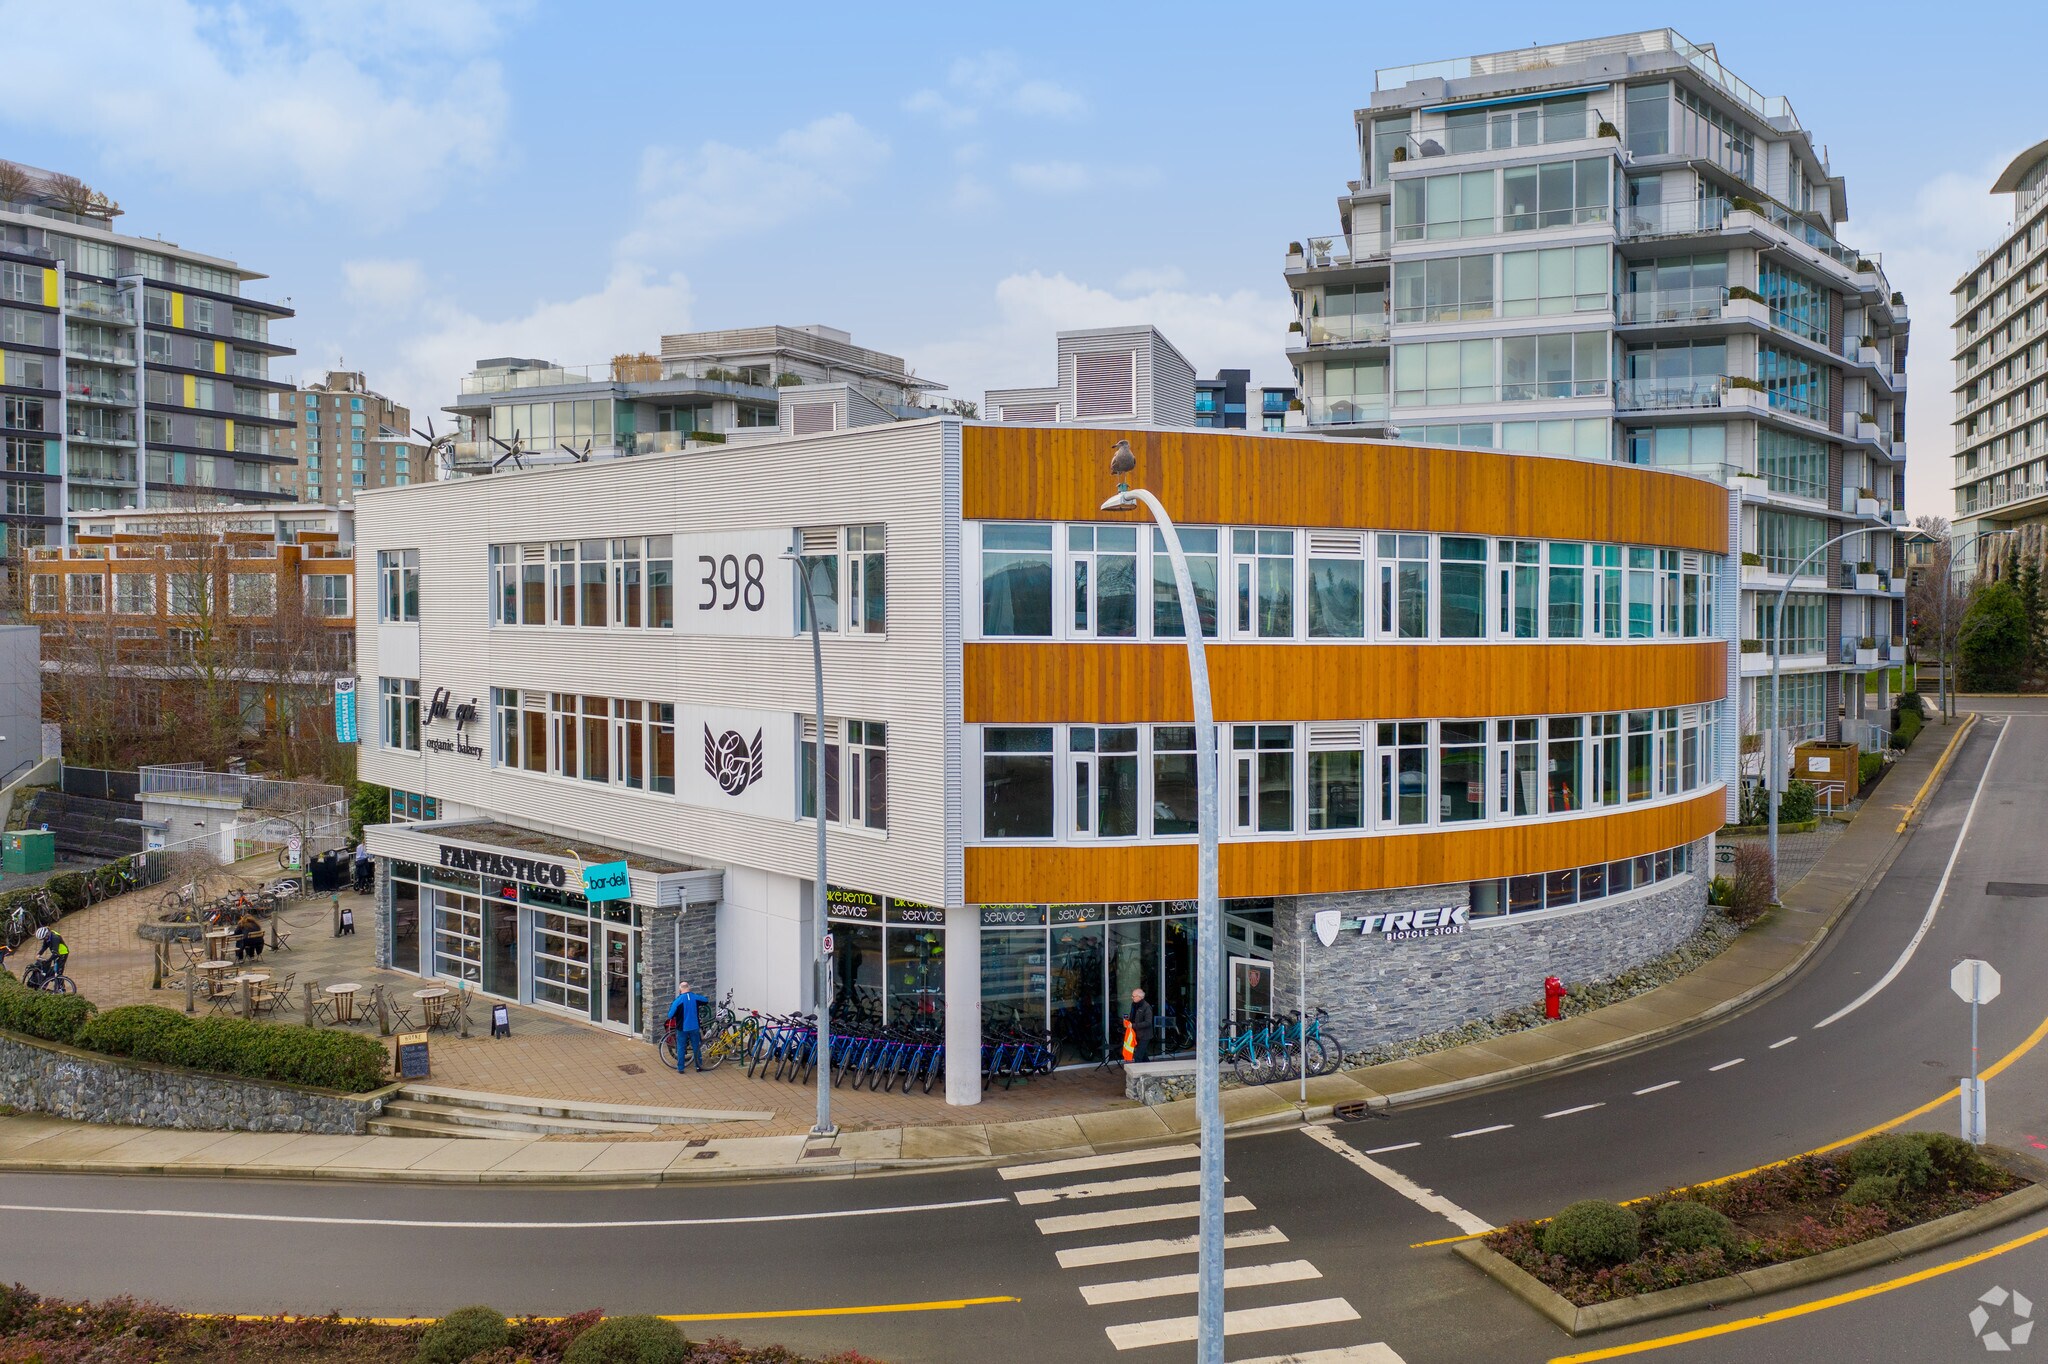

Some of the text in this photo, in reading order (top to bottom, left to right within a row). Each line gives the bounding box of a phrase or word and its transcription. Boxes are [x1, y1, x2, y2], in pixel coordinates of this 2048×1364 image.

[698, 553, 765, 612] 398
[341, 694, 351, 741] FANTASTICO
[426, 733, 483, 760] organic bakery
[438, 844, 567, 888] FANTASTICO
[589, 871, 627, 890] bar-deli
[1355, 905, 1471, 935] TREK
[1386, 926, 1464, 941] BICYCLE STORE
